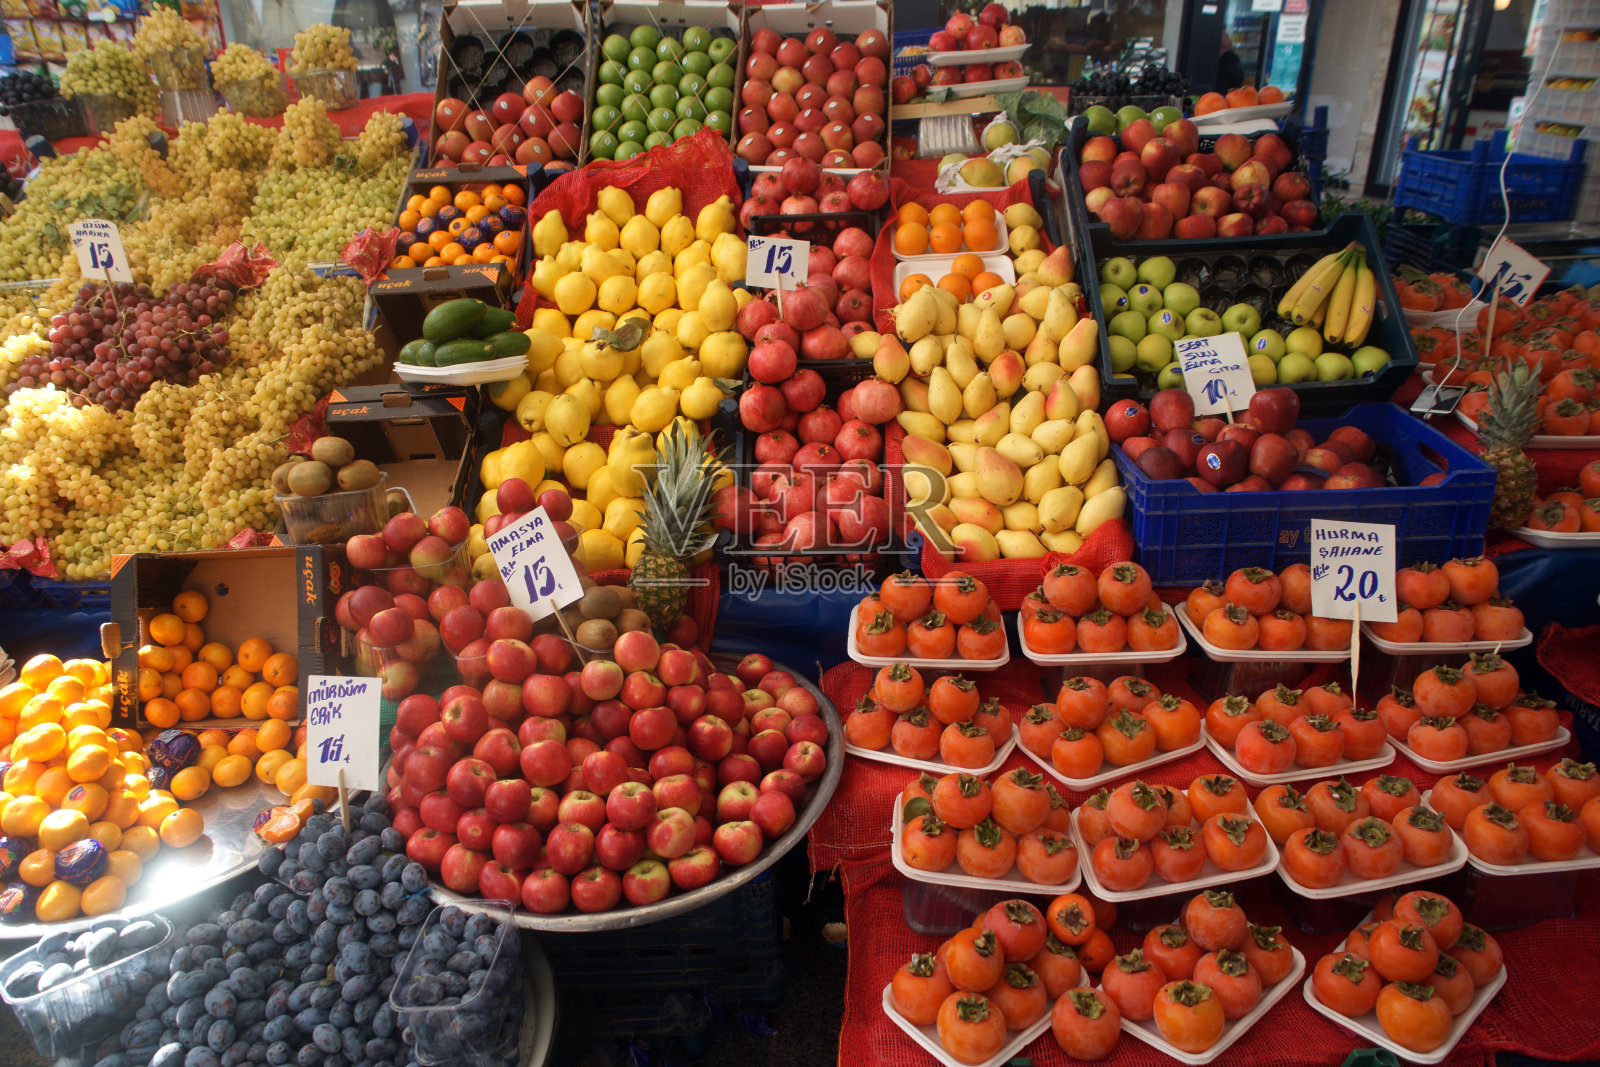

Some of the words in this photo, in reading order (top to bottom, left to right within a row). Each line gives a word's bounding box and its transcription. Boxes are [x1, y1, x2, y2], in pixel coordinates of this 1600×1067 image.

[416, 170, 448, 180] uçak
[90, 242, 114, 269] 15
[764, 244, 793, 274] 15
[377, 280, 413, 290] uçak
[1488, 260, 1533, 299] 15
[1201, 378, 1228, 406] 10
[331, 405, 373, 416] uçak
[490, 516, 544, 554] AMASYA
[511, 531, 544, 558] ELMA
[1279, 528, 1300, 548] ay
[1315, 528, 1379, 543] HURMA
[1319, 545, 1384, 559] ŞAHANE
[305, 555, 318, 605] uçak
[523, 555, 556, 604] 15
[1333, 564, 1379, 602] 20
[119, 669, 129, 719] uçak
[308, 679, 367, 705] MÜRDÜM
[317, 733, 345, 764] 15
